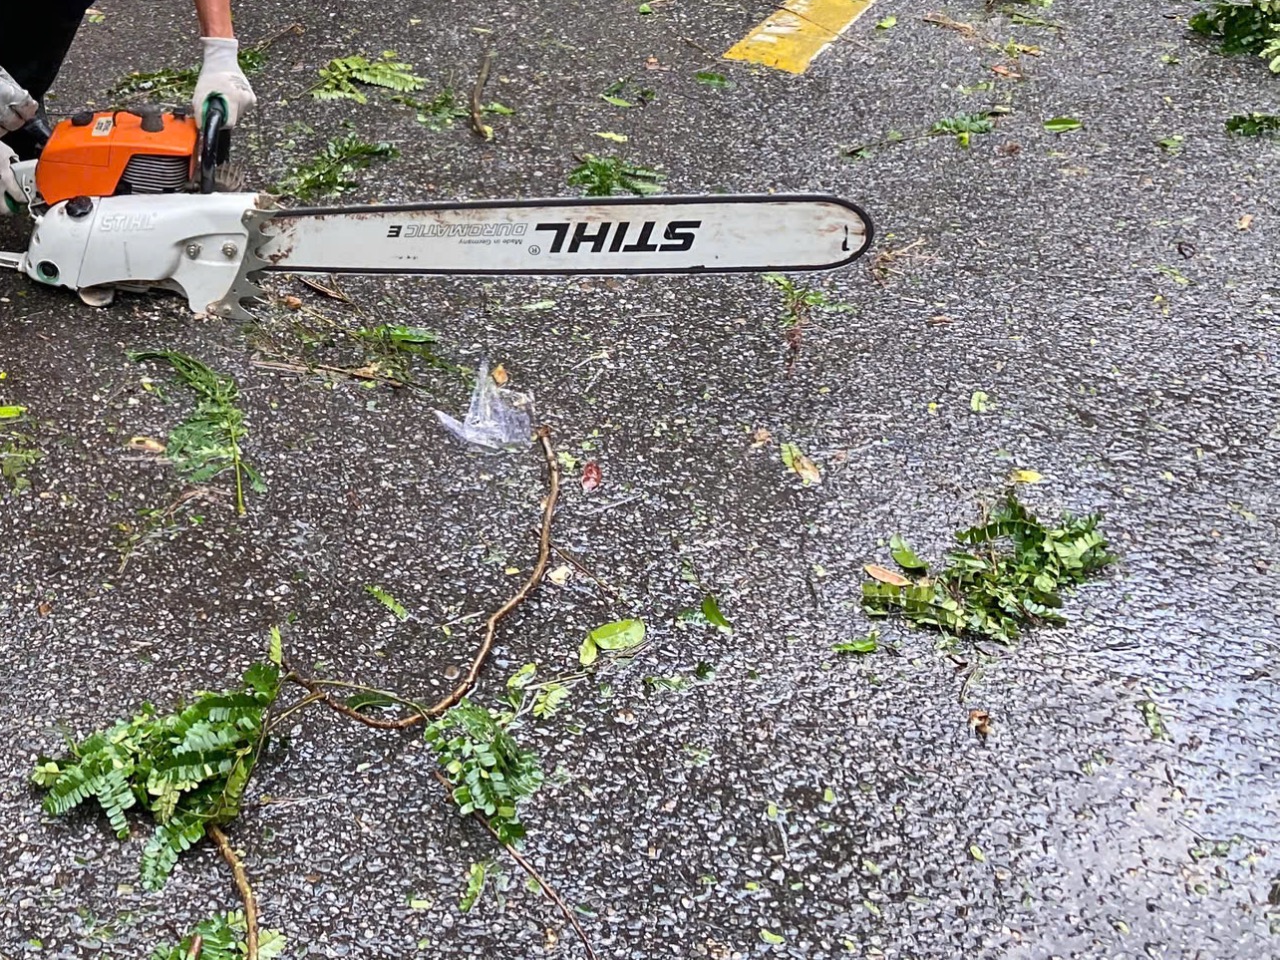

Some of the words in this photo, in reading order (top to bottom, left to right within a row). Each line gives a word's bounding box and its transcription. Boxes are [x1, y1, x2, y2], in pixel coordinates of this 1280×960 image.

[99, 213, 154, 232] STIHL
[404, 223, 528, 238] DUROMATIC
[387, 225, 402, 238] E
[535, 220, 702, 253] STIHL
